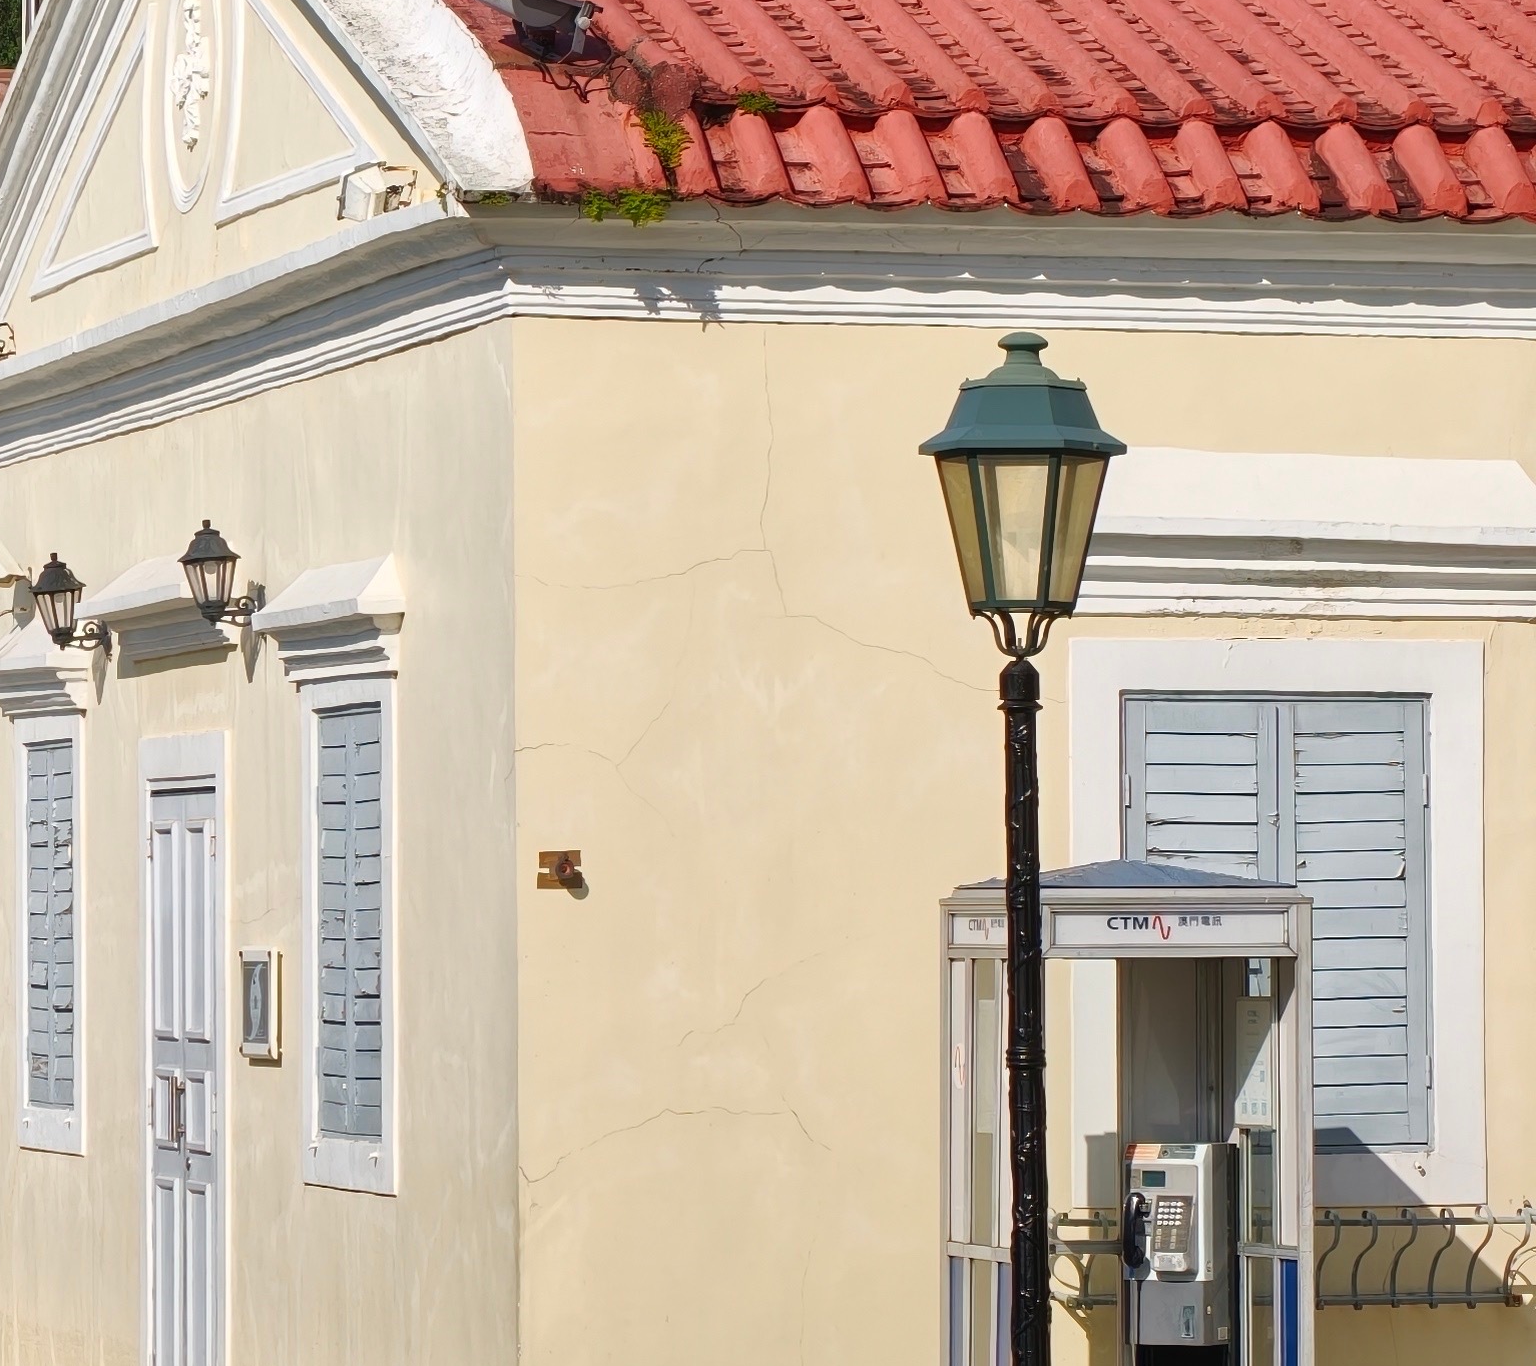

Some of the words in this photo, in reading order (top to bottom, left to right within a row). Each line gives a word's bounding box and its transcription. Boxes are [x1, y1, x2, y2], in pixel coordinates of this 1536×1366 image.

[968, 918, 982, 931] CTM
[1106, 916, 1149, 930] CTM
[1177, 915, 1223, 927] 澳門電訊
